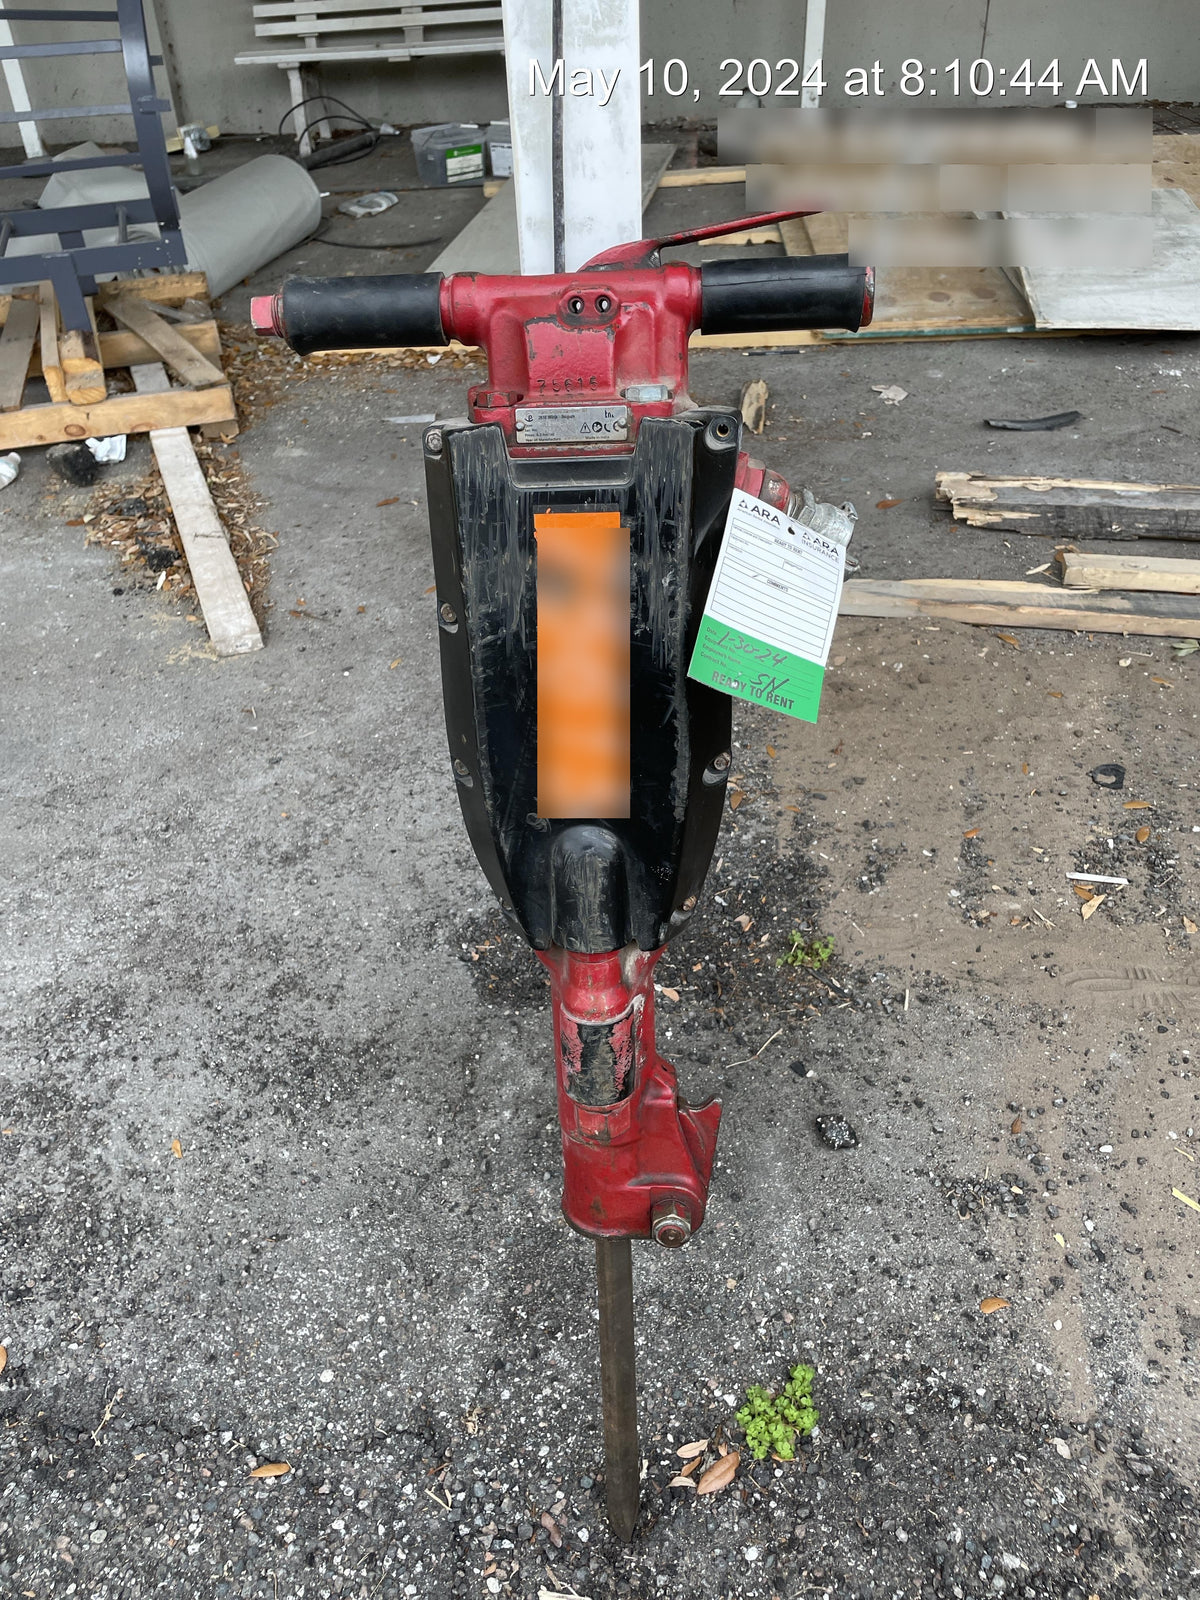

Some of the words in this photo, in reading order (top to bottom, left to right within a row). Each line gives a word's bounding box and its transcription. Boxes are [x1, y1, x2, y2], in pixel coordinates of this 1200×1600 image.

[751, 505, 780, 525] ARA
[802, 539, 839, 563] INSURANCE
[767, 579, 789, 593] COMMENTS
[706, 626, 717, 635] Date
[712, 671, 747, 692] READY
[750, 685, 763, 698] TO
[766, 691, 795, 709] RENT
